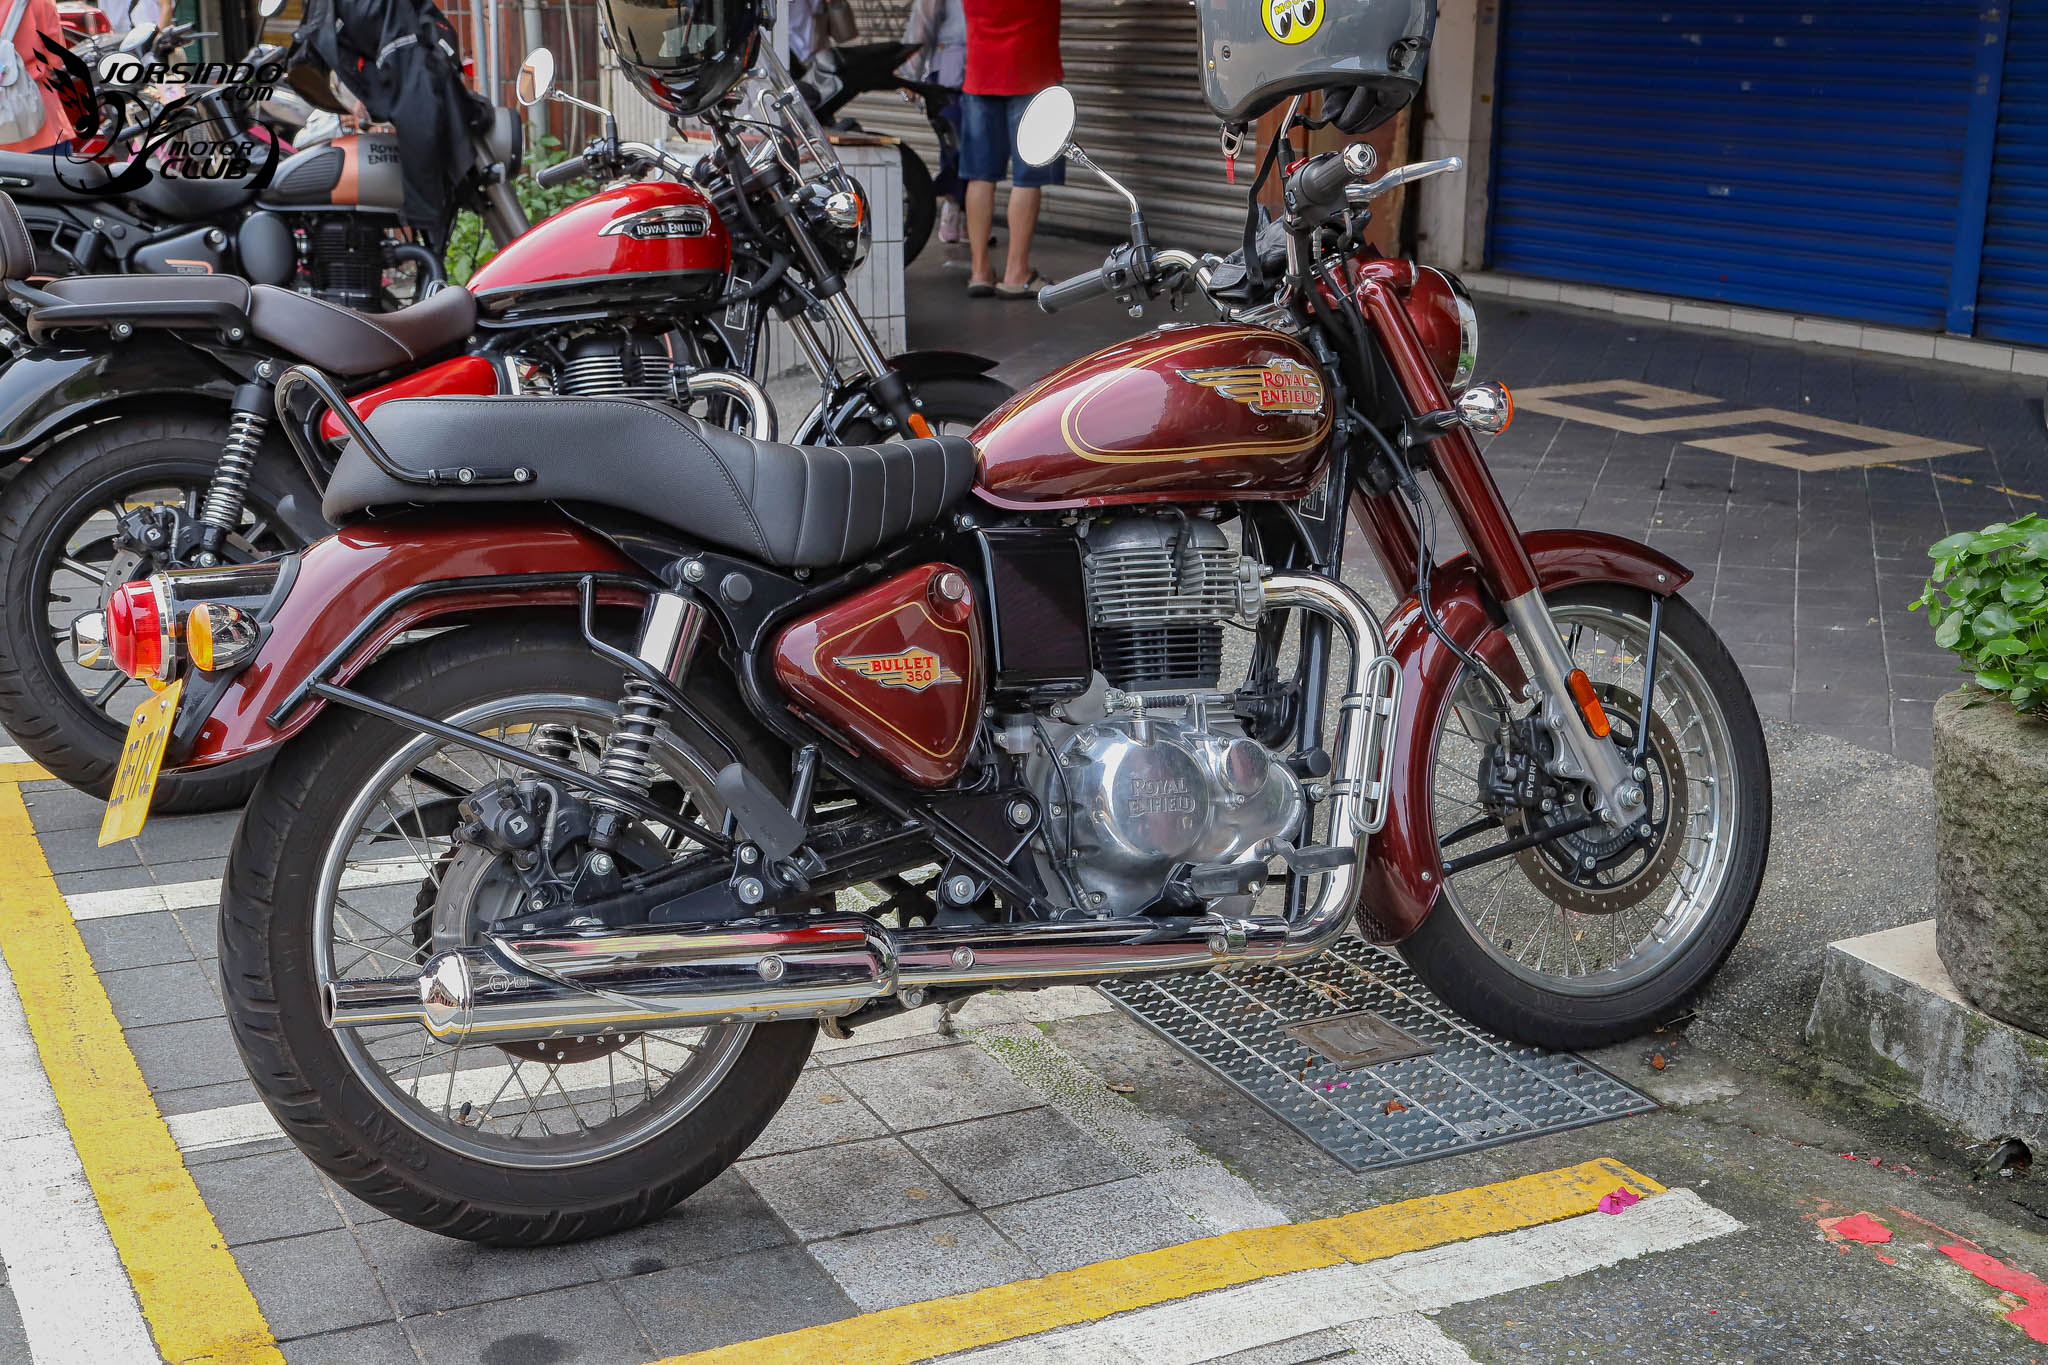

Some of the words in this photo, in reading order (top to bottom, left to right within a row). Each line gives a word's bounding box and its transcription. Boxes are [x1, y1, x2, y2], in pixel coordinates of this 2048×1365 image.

[1274, 0, 1304, 15] MOO
[370, 143, 400, 153] ROYA
[636, 224, 669, 235] ROYAL
[1263, 371, 1308, 388] ROYAL
[1261, 390, 1316, 406] ENFIELD
[871, 656, 933, 672] BULLET
[906, 670, 931, 682] 350
[1130, 777, 1188, 797] ROYAL
